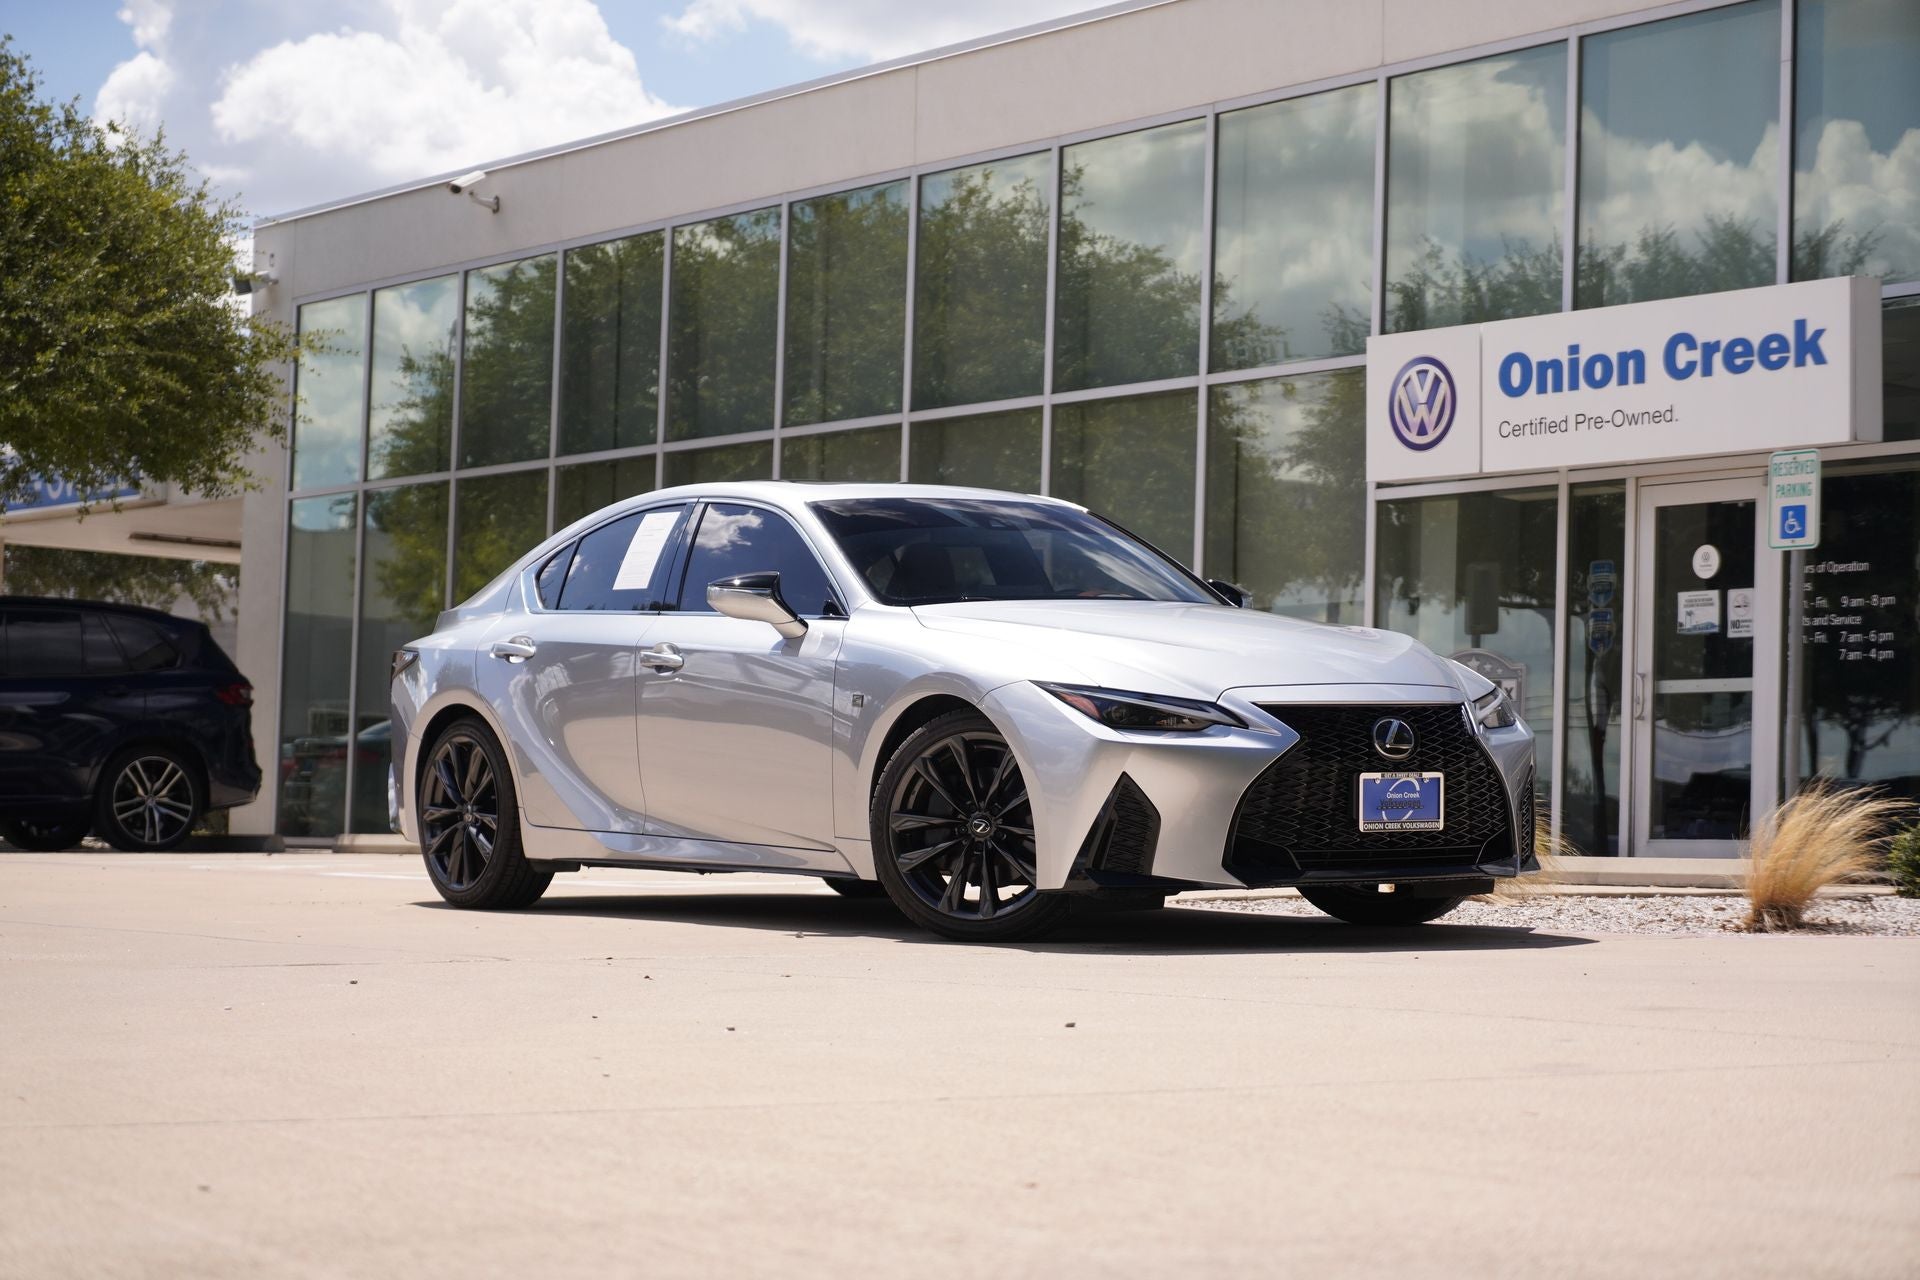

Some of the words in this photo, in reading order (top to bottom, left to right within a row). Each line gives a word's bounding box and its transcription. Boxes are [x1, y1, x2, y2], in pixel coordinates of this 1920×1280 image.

[1498, 344, 1646, 398] Onion
[1663, 319, 1828, 381] Creek
[1498, 415, 1568, 438] Certified
[1575, 404, 1679, 431] Pre-Owned.
[1772, 459, 1816, 477] RESERVED
[1775, 482, 1812, 498] PARKING
[1826, 561, 1870, 575] Operation
[1811, 614, 1829, 626] and
[1828, 613, 1863, 626] Service
[1386, 791, 1403, 799] Onion
[1403, 791, 1420, 799] Creek
[1363, 822, 1384, 830] ONION
[1384, 822, 1402, 830] CREEK
[1402, 821, 1440, 830] VOLKSWAGEN
